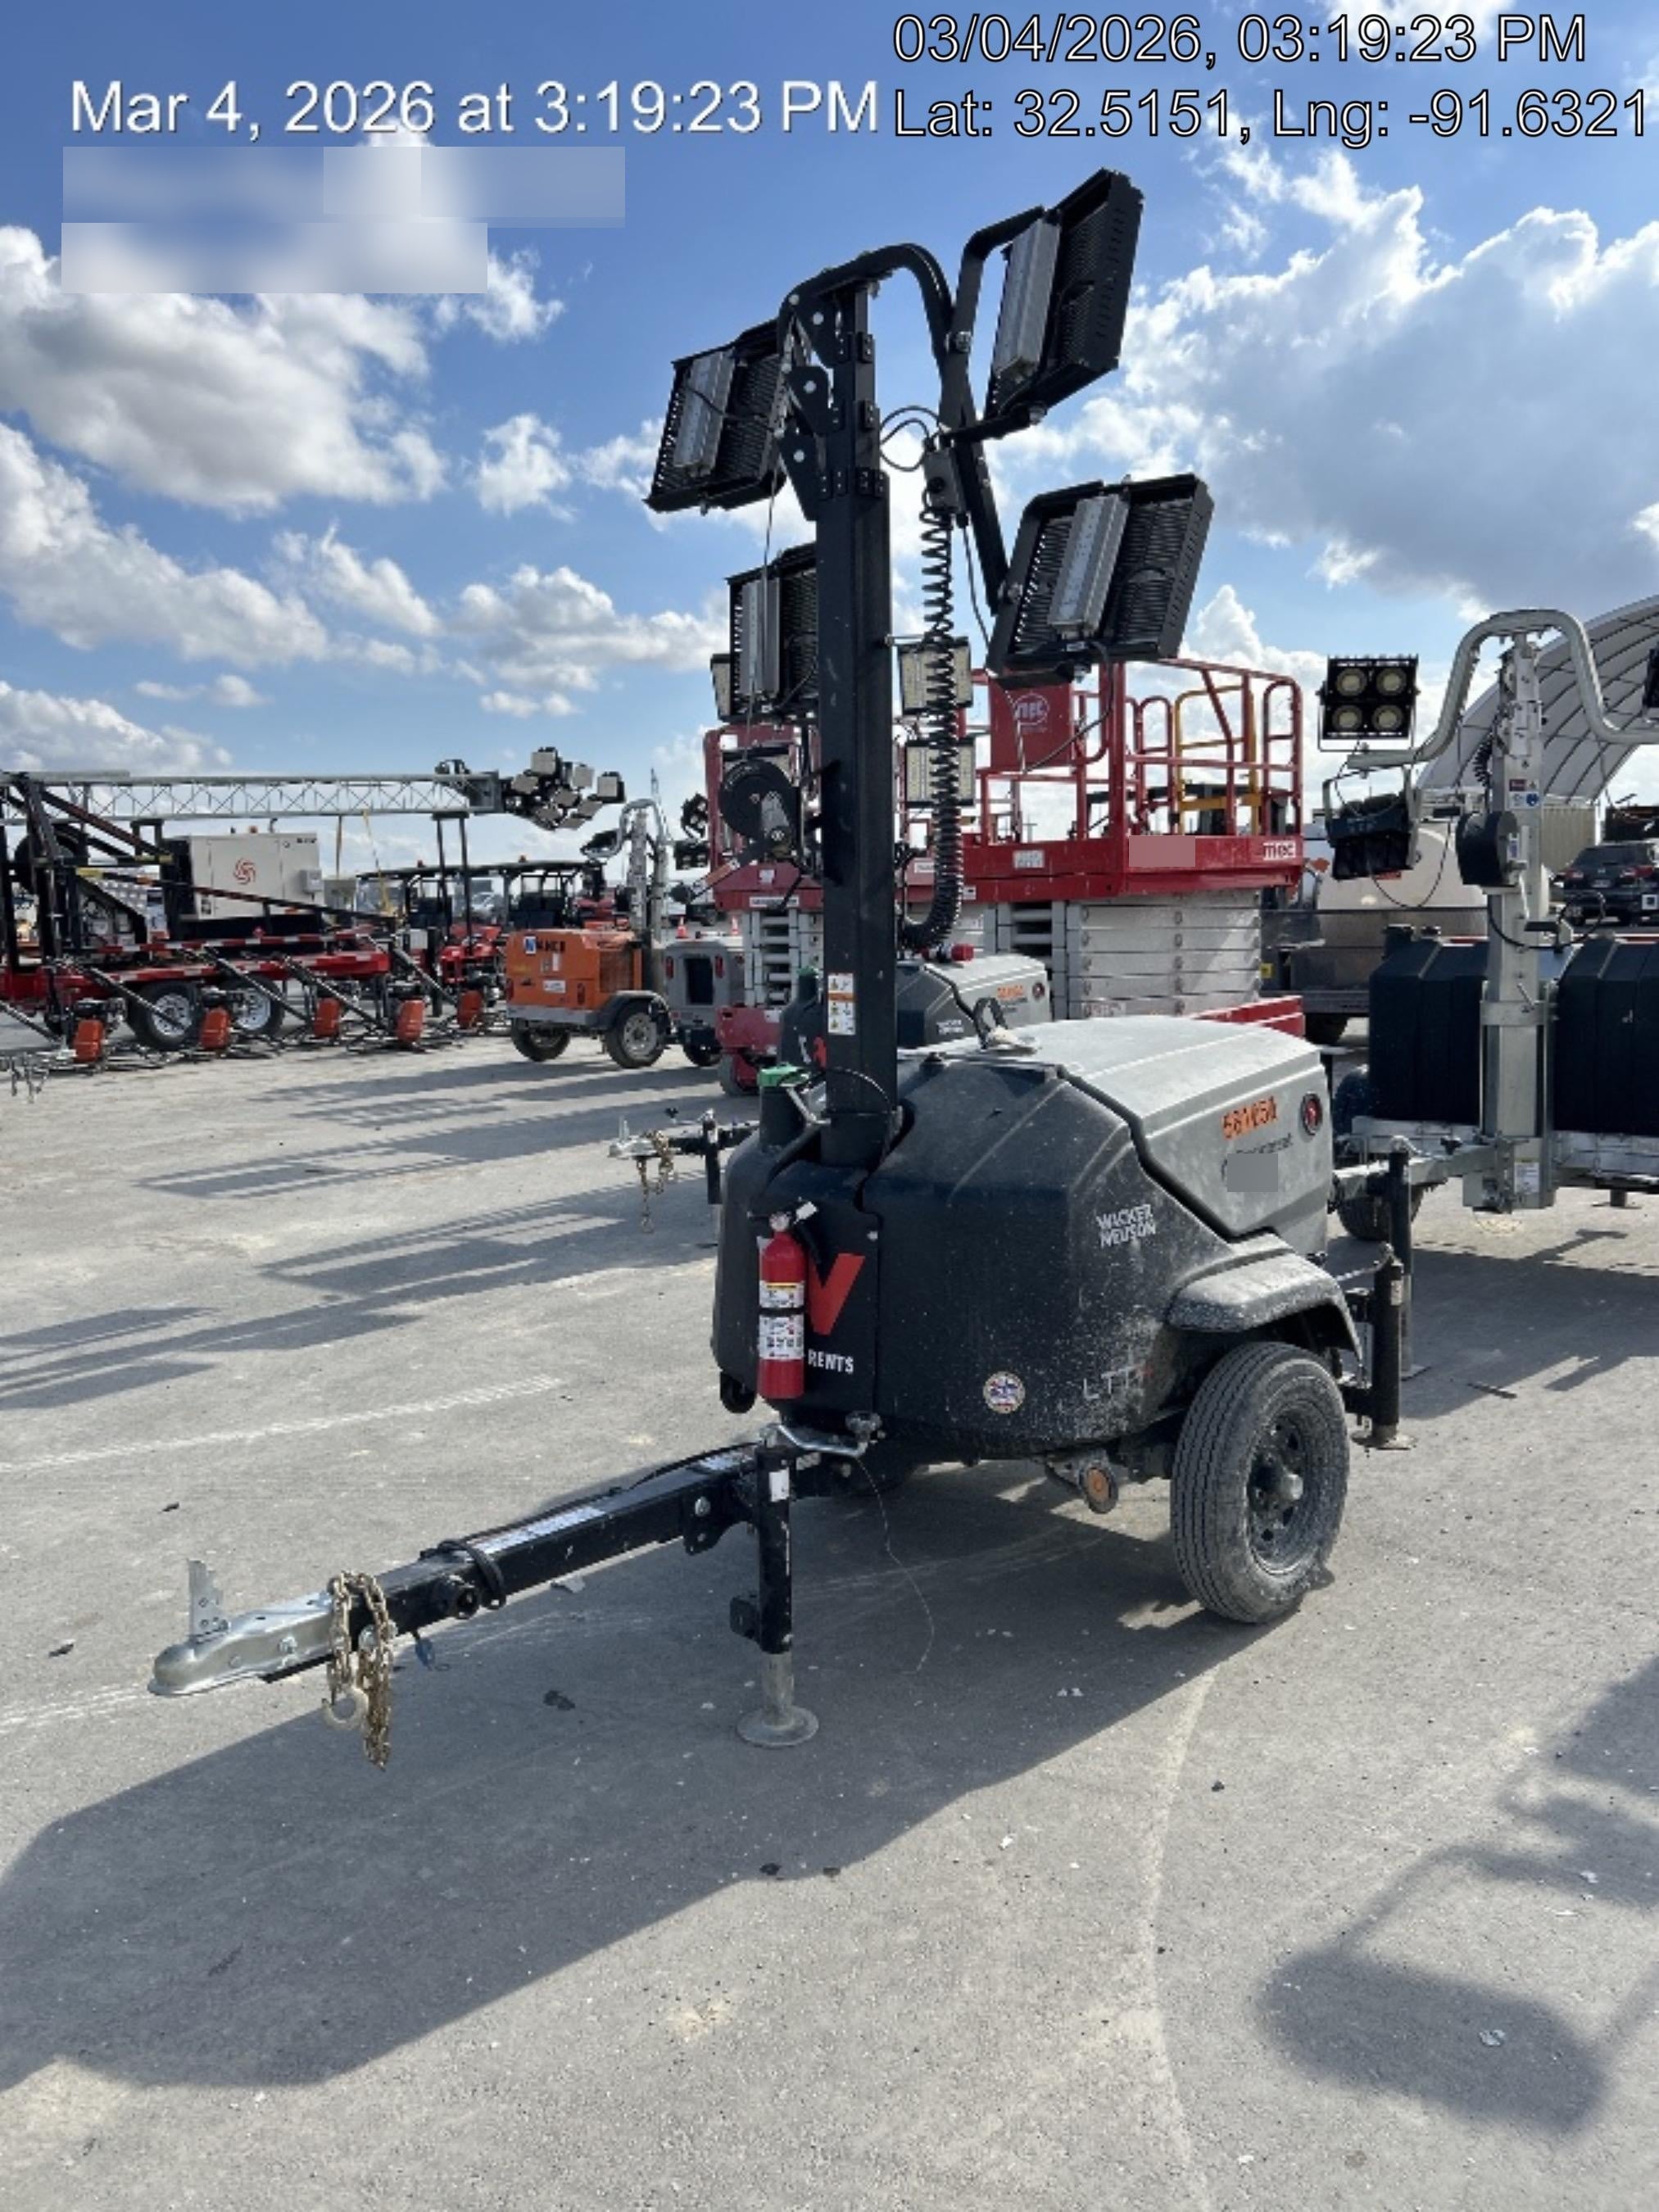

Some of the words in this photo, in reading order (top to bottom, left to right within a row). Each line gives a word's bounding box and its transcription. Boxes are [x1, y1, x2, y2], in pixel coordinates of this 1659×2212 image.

[1096, 1203, 1154, 1231] WACKER
[1099, 1222, 1156, 1249] NEUSON
[808, 1349, 854, 1374] RENTS
